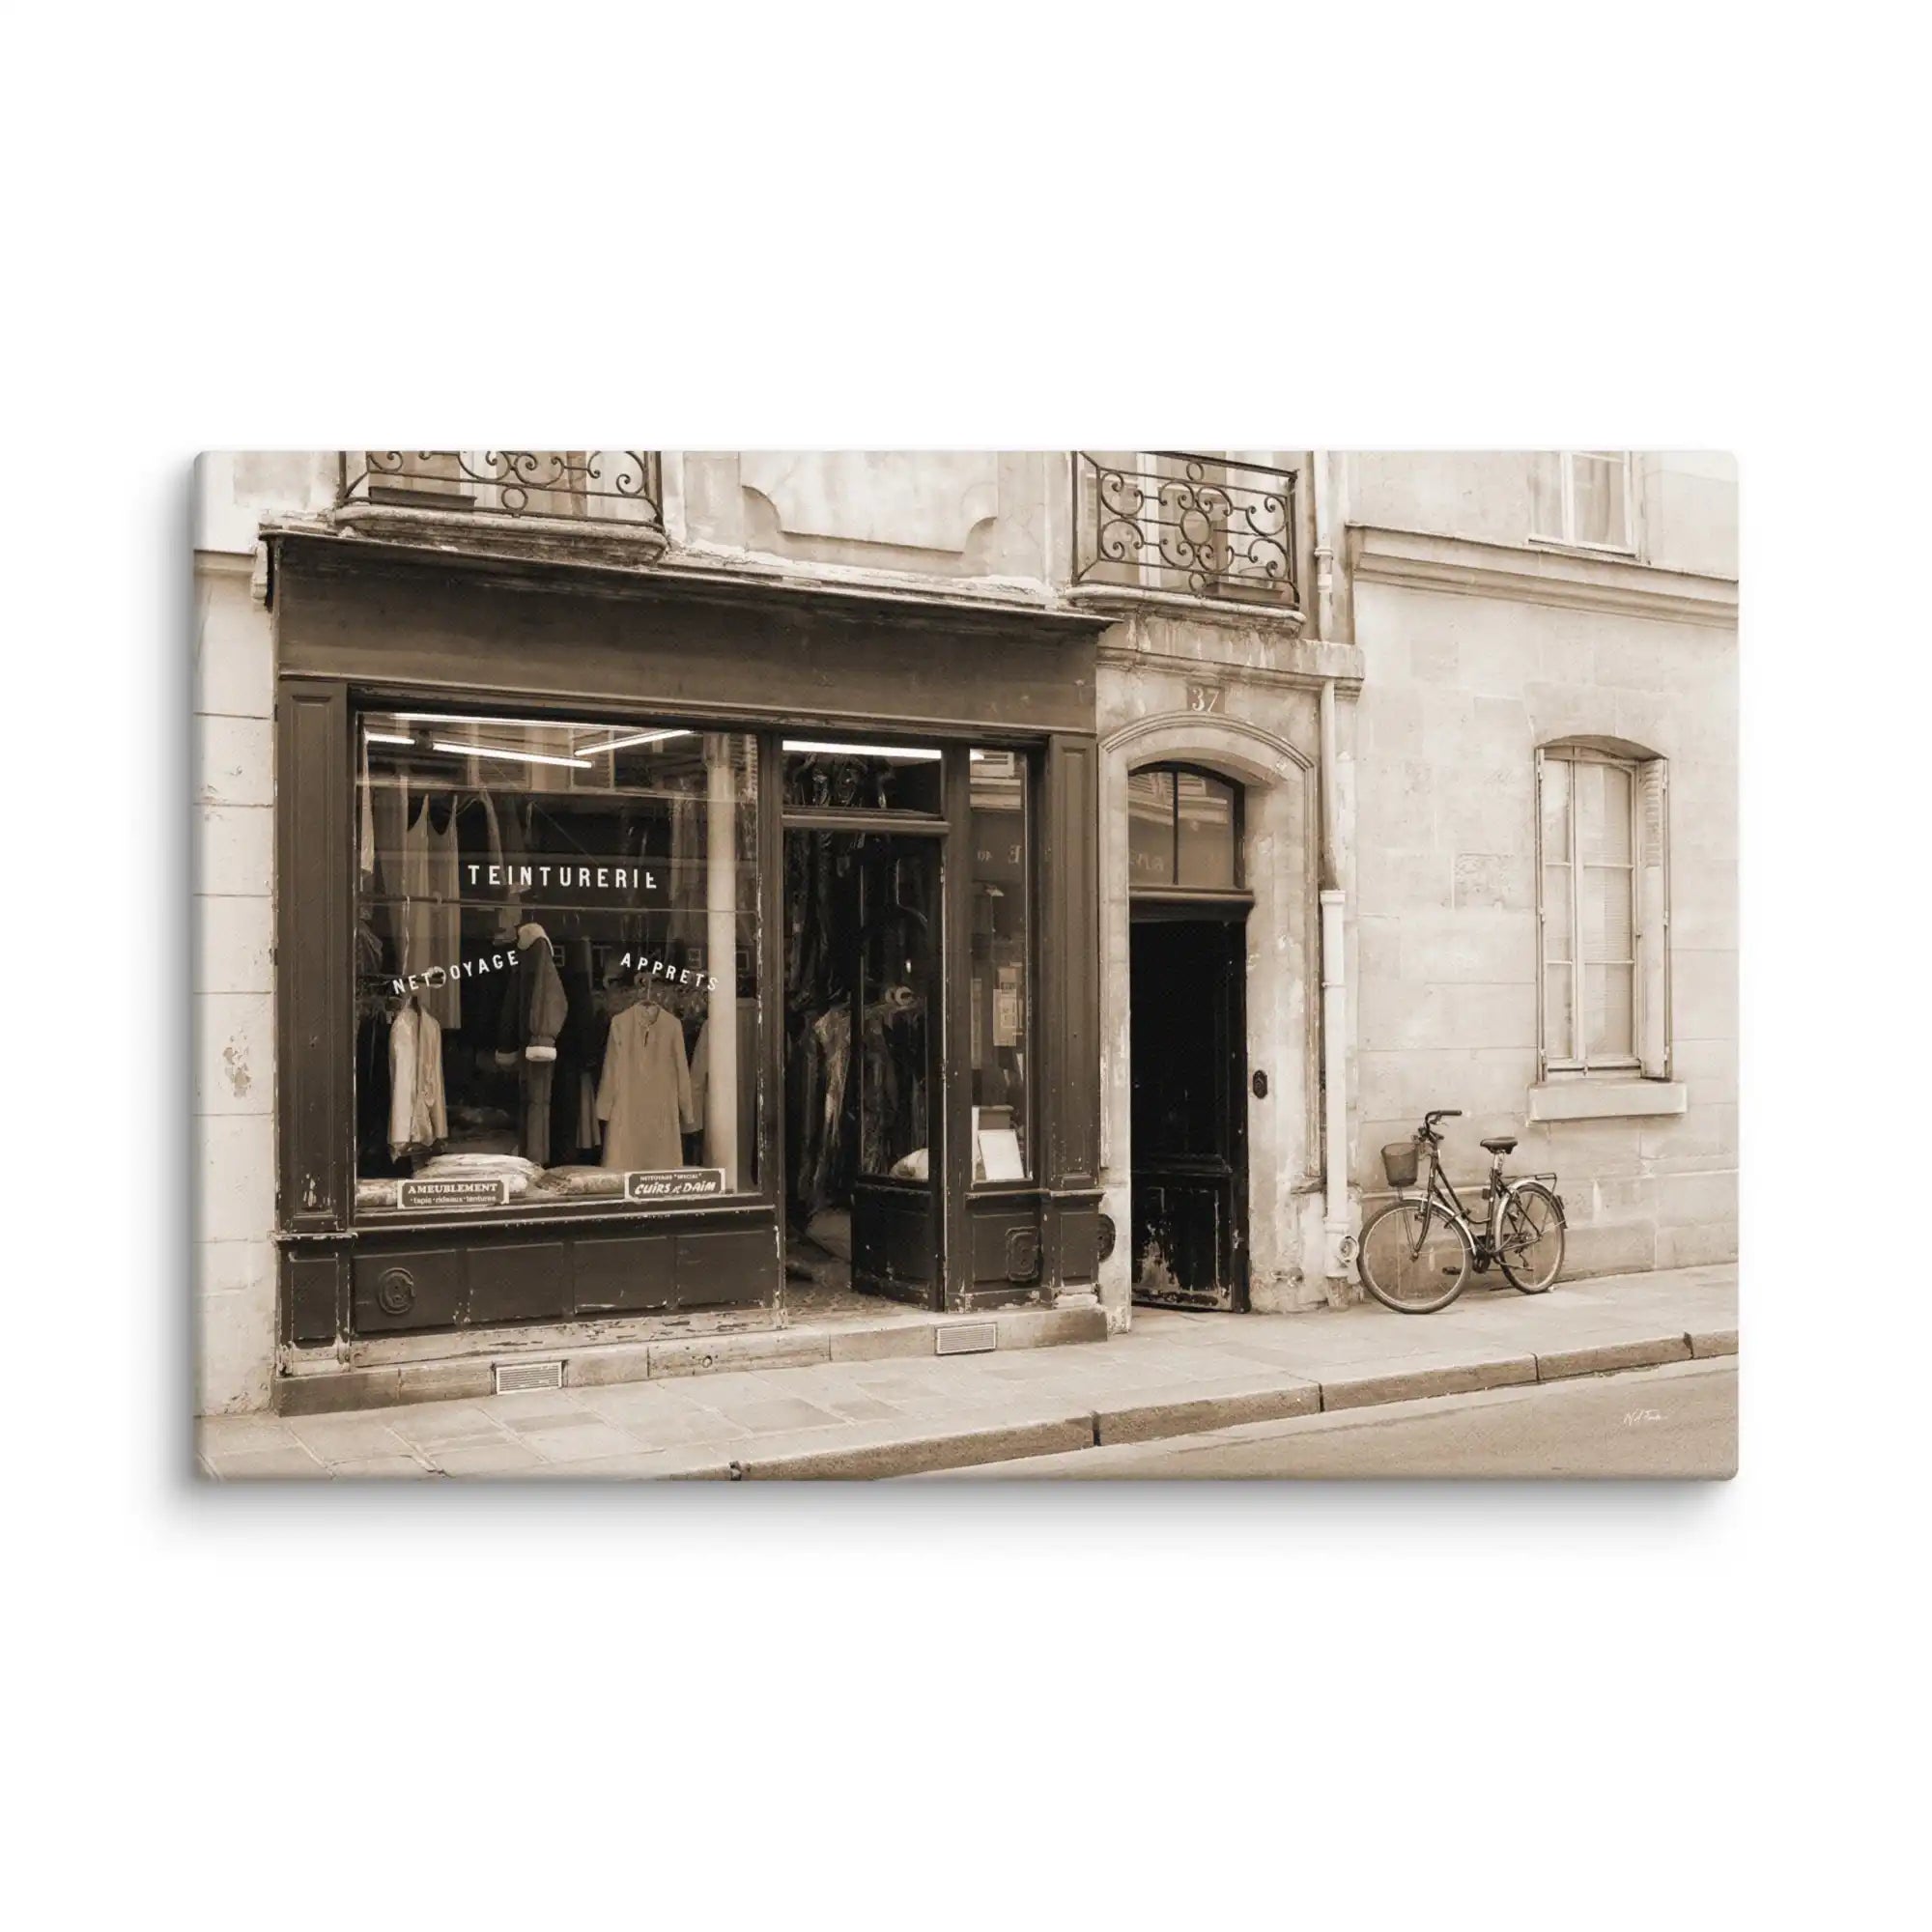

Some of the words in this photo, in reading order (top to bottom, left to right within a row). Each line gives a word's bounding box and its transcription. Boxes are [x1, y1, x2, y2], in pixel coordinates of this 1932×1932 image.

[1191, 687, 1219, 713] 37
[468, 865, 657, 889] TEINTURERIE
[392, 950, 519, 995] NETOYAGE
[620, 952, 719, 991] APPRETS
[408, 1183, 498, 1195] AMEUBLEMENT
